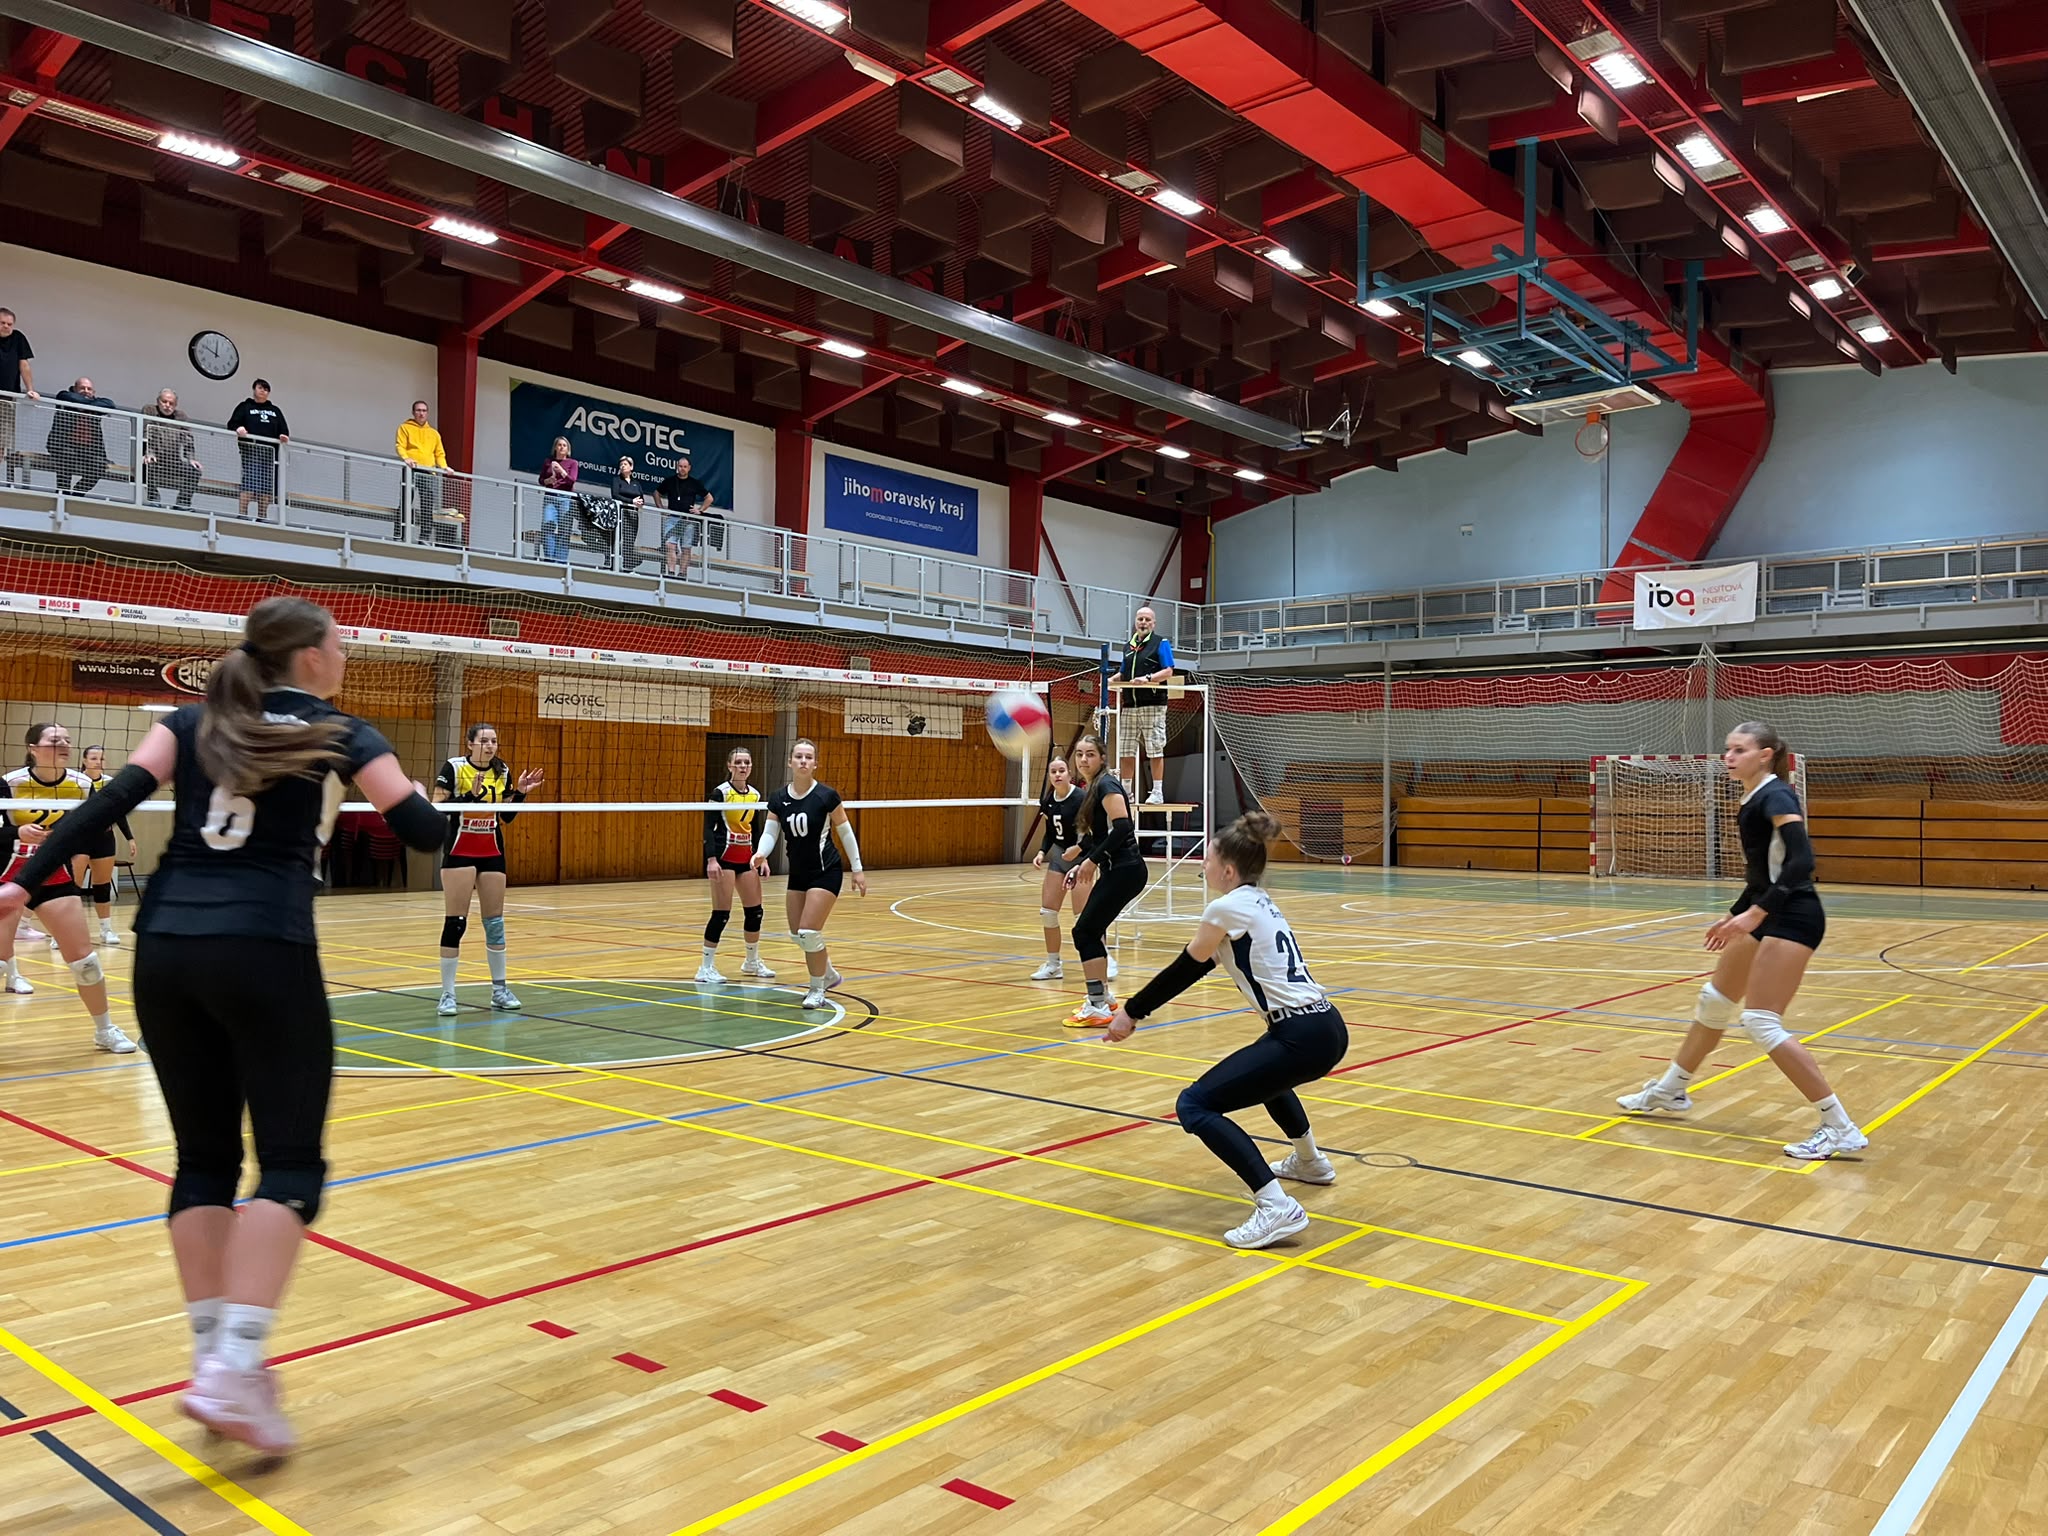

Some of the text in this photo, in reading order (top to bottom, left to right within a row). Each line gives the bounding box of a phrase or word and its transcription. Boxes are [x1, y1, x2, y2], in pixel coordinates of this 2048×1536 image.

[564, 406, 691, 455] AGROTEC
[607, 466, 617, 475] TJ
[843, 477, 964, 521] jihomoravský kraj
[48, 600, 71, 609] MOSS
[1702, 593, 1737, 605] ENERGIE
[78, 663, 156, 677] www.bison.cz
[544, 693, 605, 708] AGROTEC
[582, 708, 602, 717] Group
[851, 713, 894, 725] AGROTEC
[470, 820, 490, 828] MOSS
[787, 812, 808, 838] 10
[1053, 814, 1065, 840] 5
